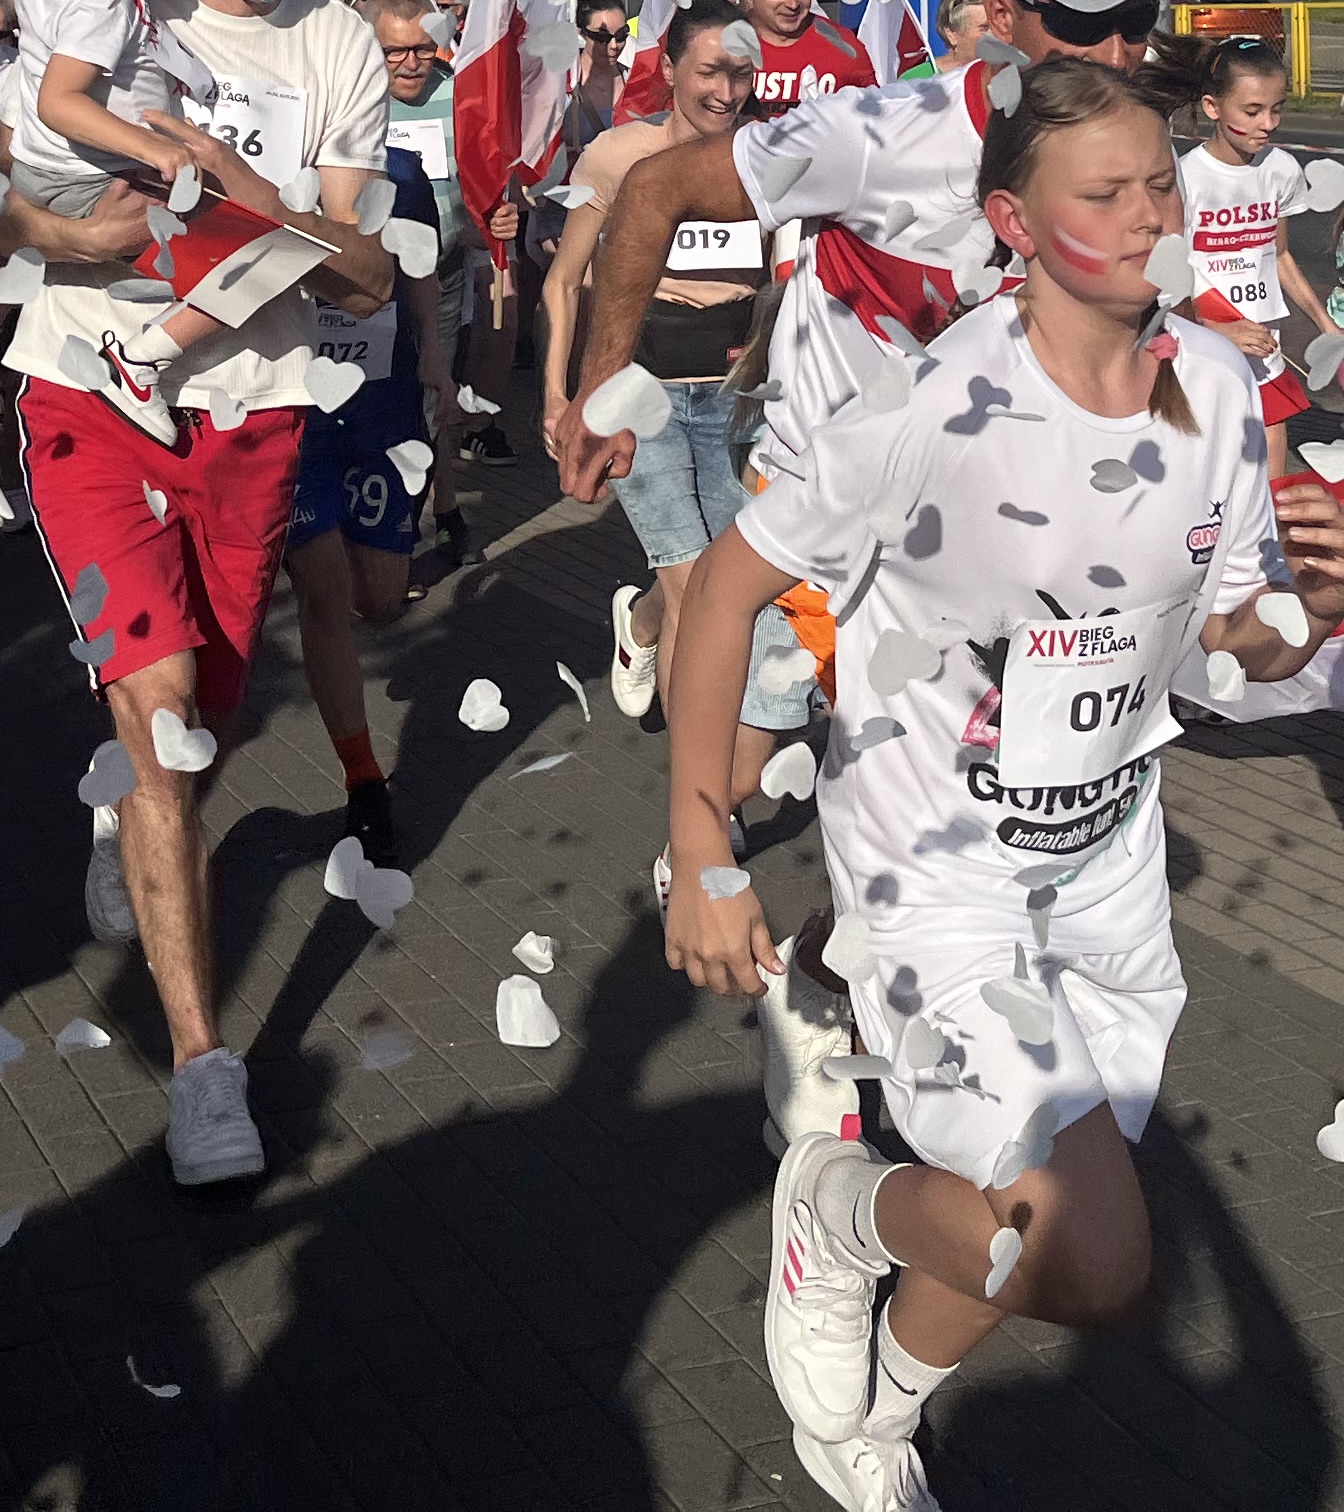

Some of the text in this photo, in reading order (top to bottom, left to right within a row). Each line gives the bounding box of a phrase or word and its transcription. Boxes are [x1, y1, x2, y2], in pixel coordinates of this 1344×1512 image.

[753, 72, 797, 100] UST
[677, 229, 731, 249] 019
[1230, 281, 1267, 303] 088
[318, 340, 369, 362] 072
[1026, 625, 1114, 657] XIV BIEG
[1078, 643, 1089, 657] Z
[1070, 673, 1147, 732] 074
[1007, 821, 1092, 850] Inflatable
